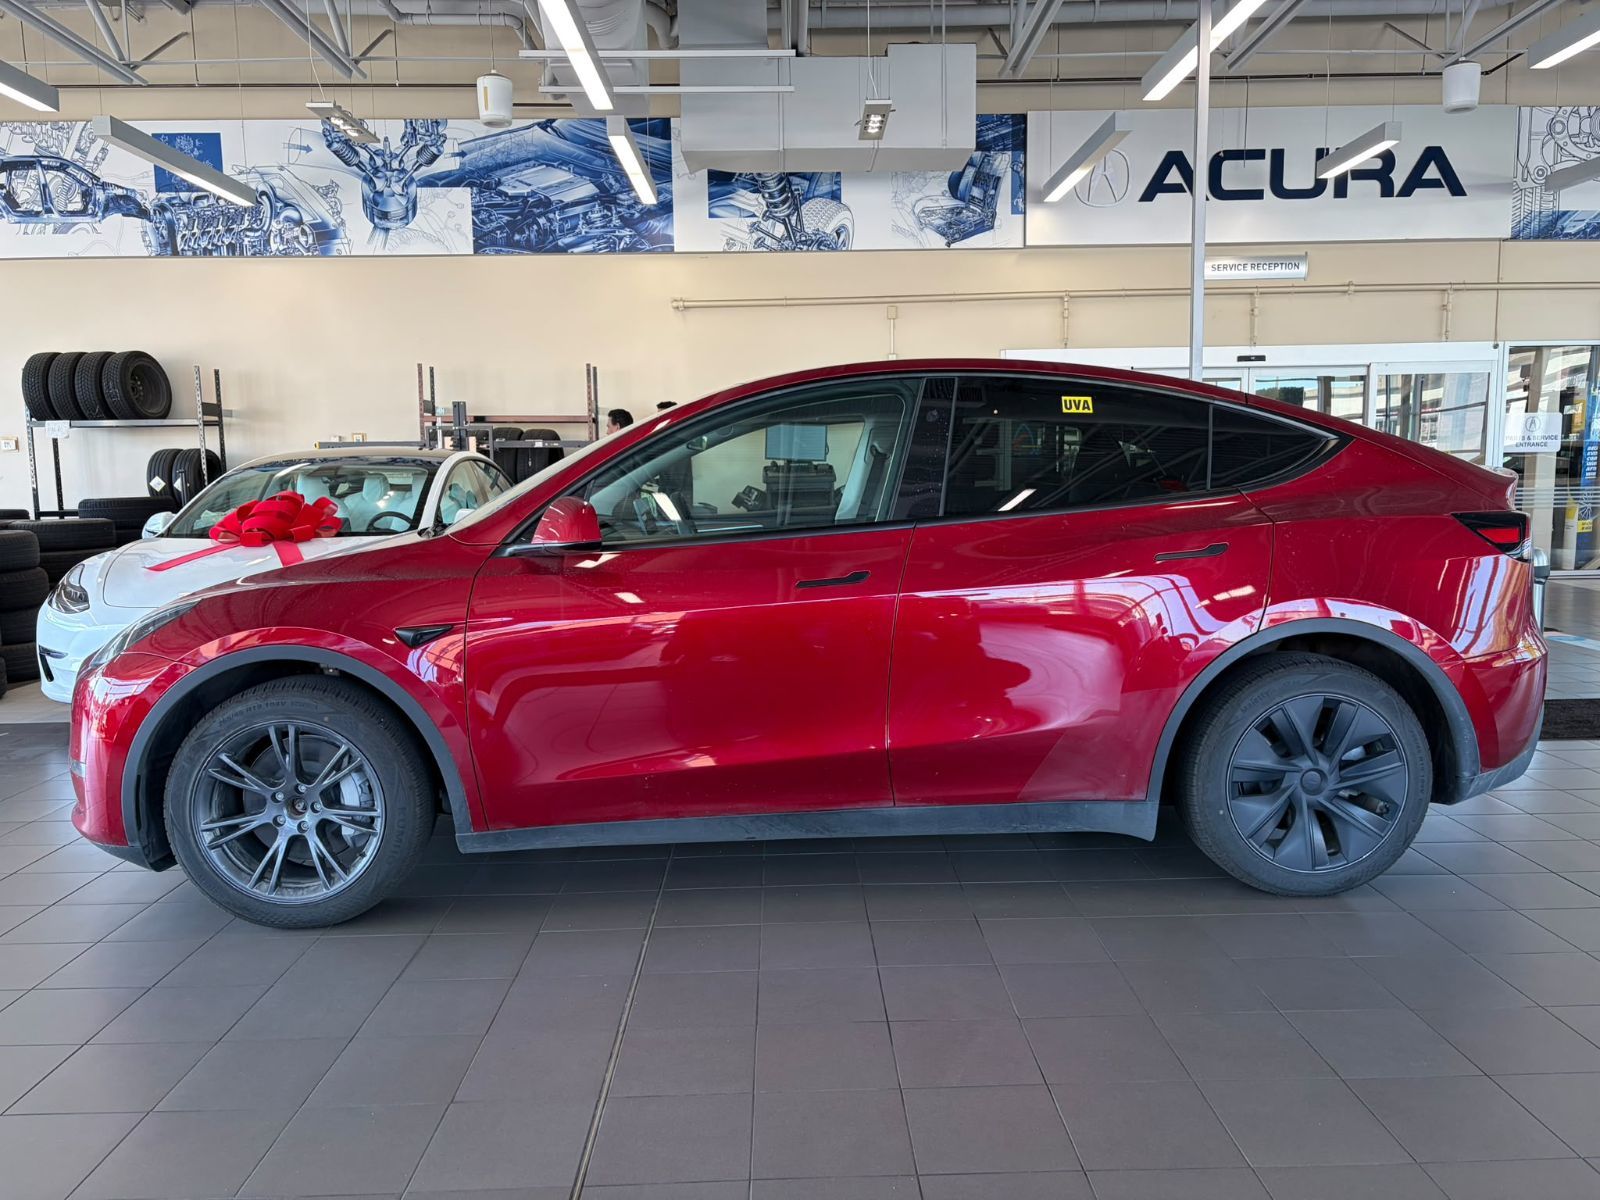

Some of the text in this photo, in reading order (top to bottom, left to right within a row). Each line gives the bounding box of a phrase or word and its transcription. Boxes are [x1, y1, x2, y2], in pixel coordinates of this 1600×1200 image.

[1138, 146, 1467, 202] ACURA
[1211, 262, 1300, 272] SERVICE RECEPTION
[1063, 399, 1091, 411] UVA
